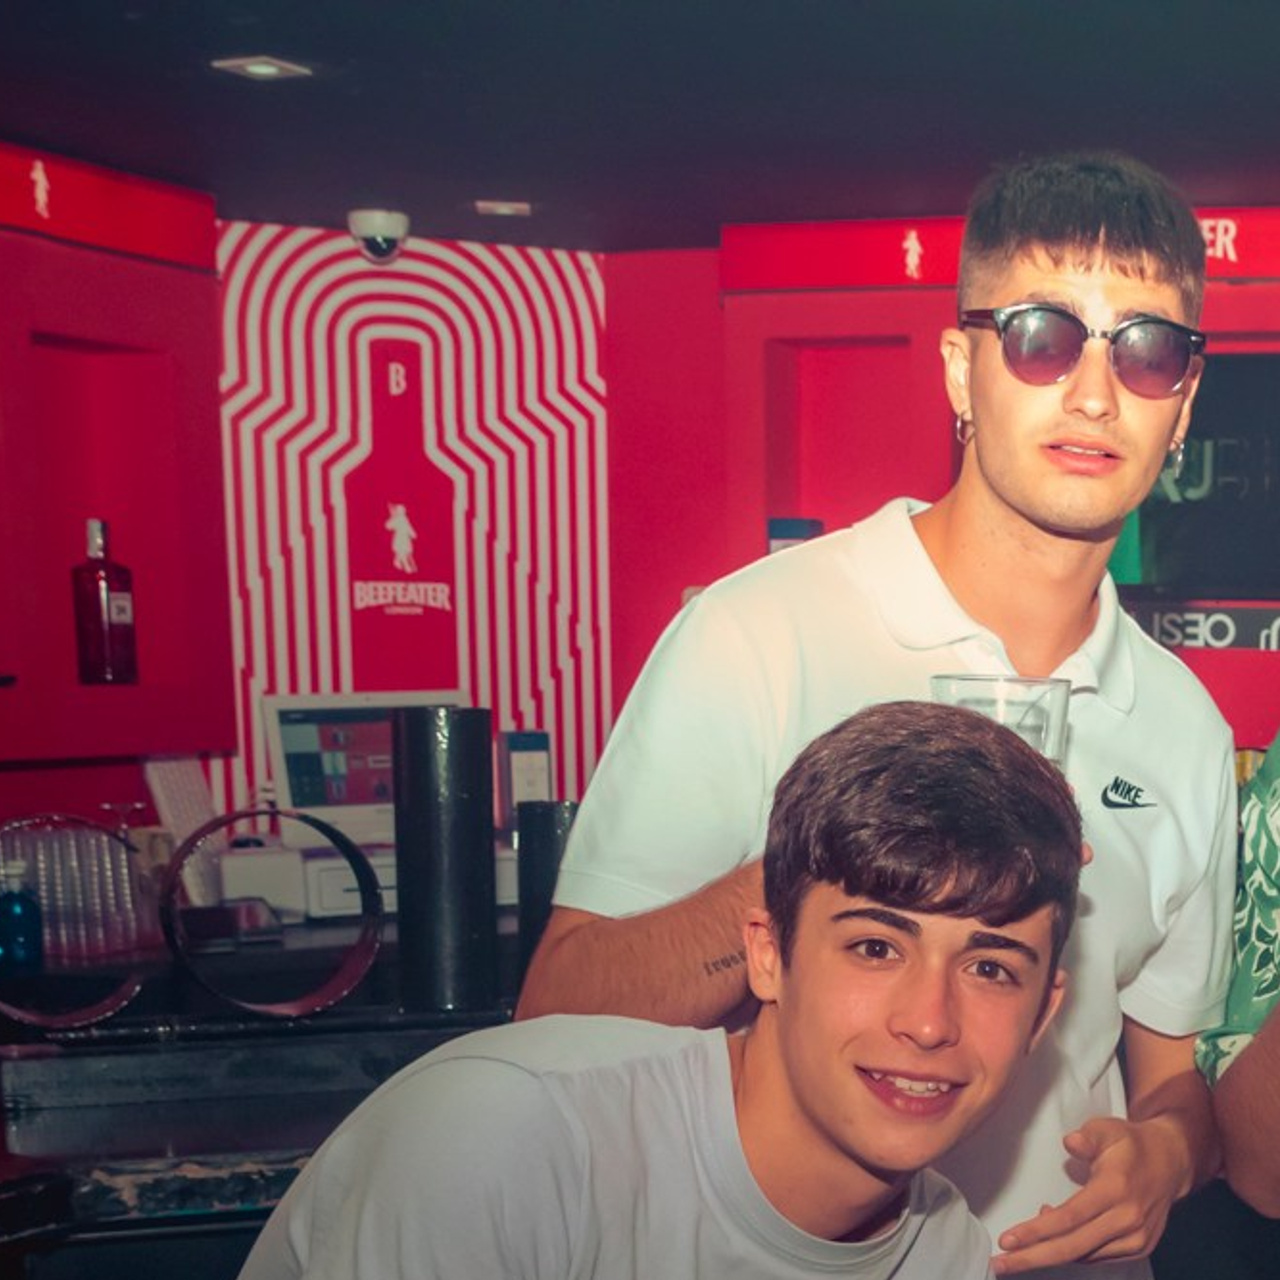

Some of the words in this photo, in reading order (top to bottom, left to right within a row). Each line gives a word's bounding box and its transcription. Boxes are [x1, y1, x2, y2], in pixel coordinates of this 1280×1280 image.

[1200, 218, 1238, 262] ER
[388, 361, 407, 396] B
[353, 580, 453, 612] BEEFEATER
[1153, 612, 1237, 648] ISEO
[1110, 775, 1144, 805] NIKE
